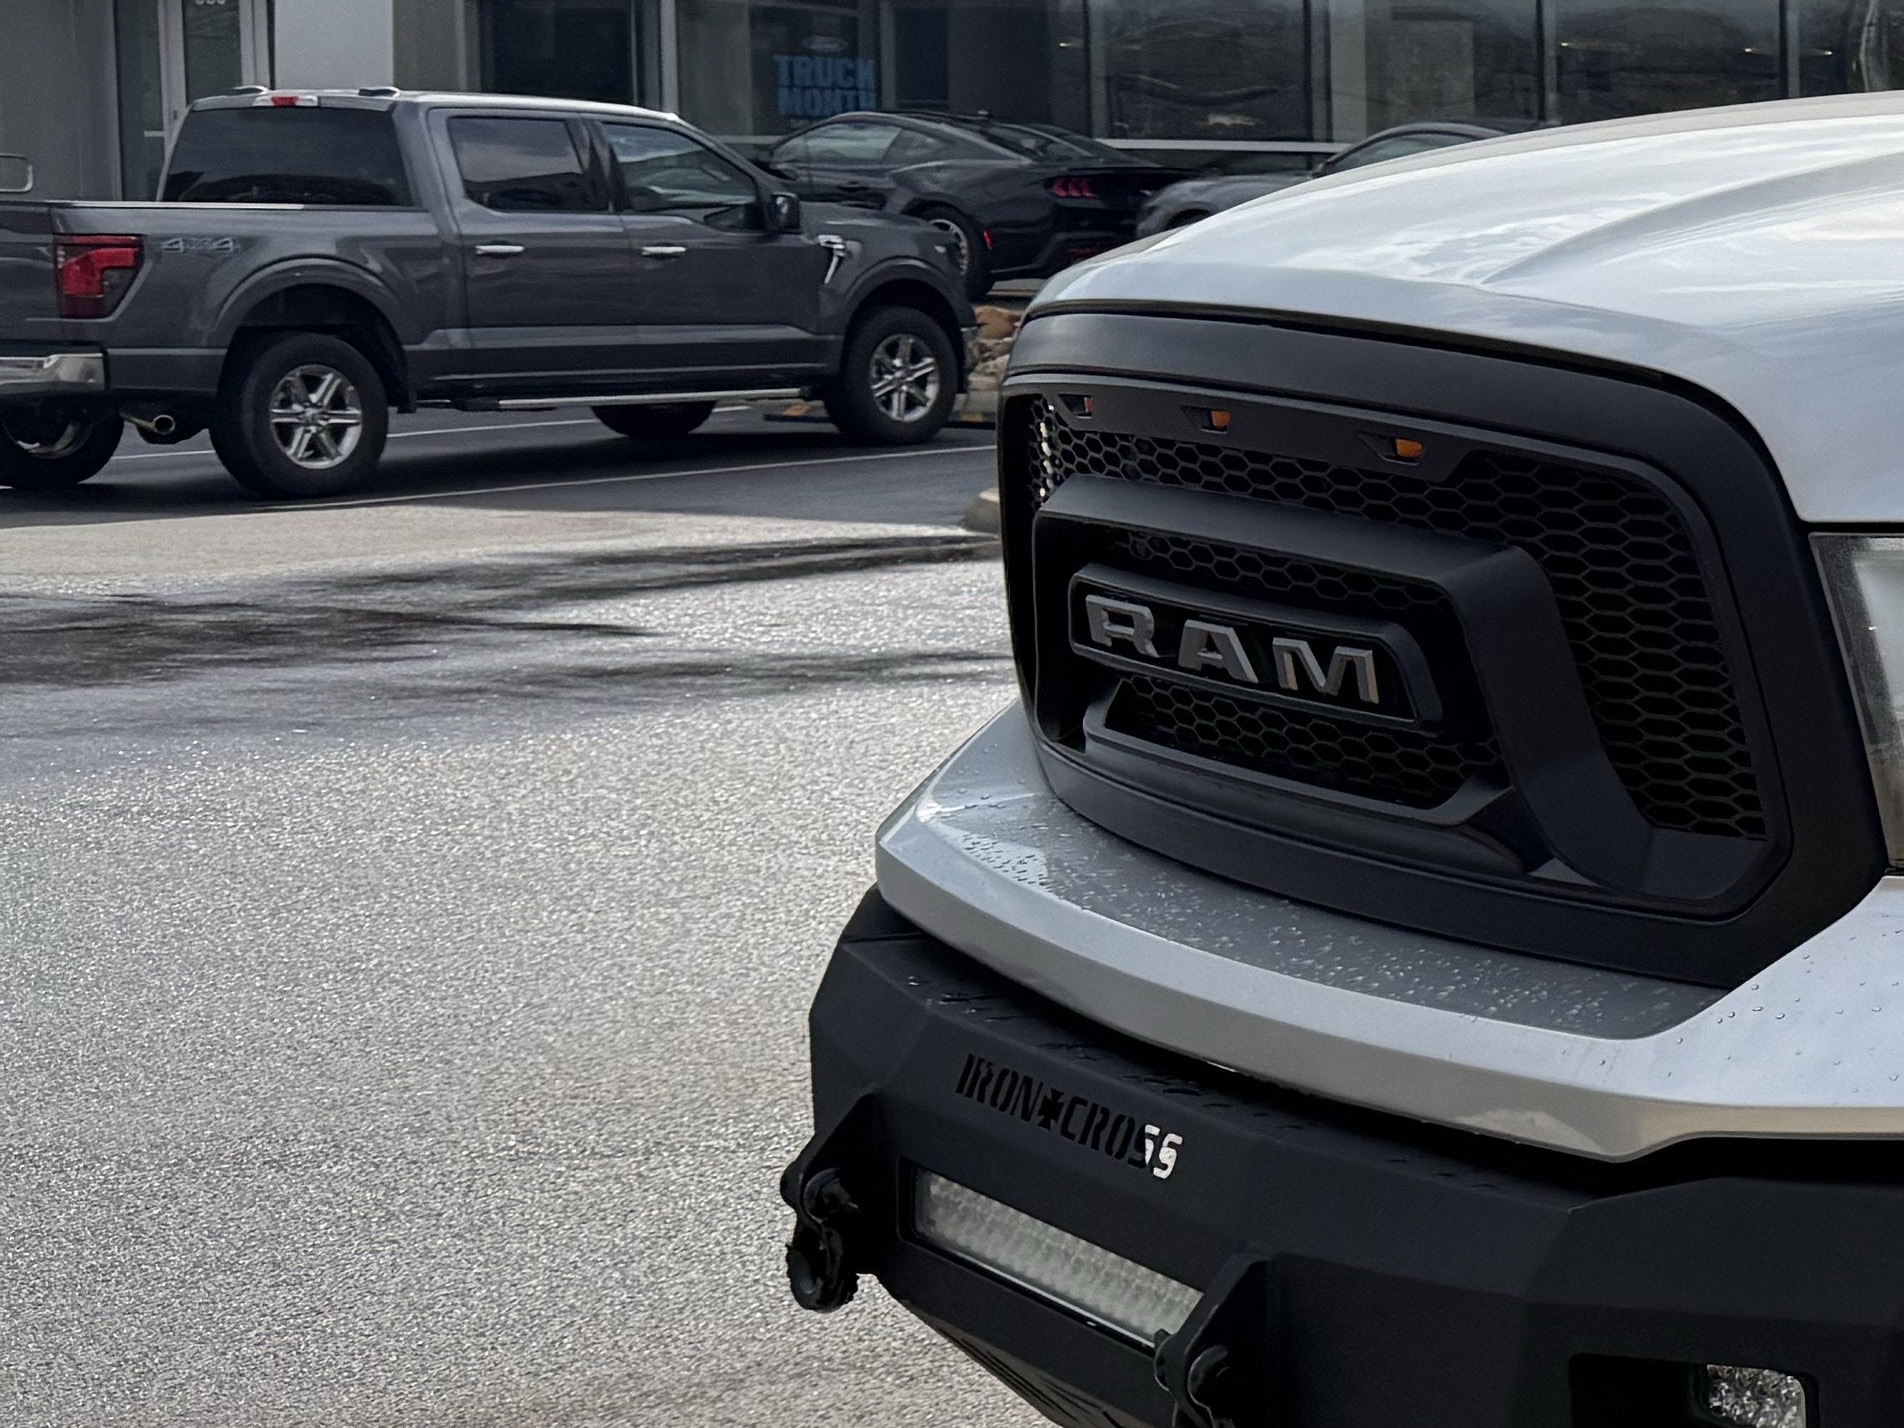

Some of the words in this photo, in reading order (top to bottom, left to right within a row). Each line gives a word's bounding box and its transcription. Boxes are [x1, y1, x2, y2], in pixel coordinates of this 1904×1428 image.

[773, 54, 876, 90] TRUCK
[777, 87, 877, 118] MONTH
[1085, 594, 1379, 704] RAM
[956, 1053, 1044, 1122] IRON
[1060, 1095, 1183, 1179] CROSS
